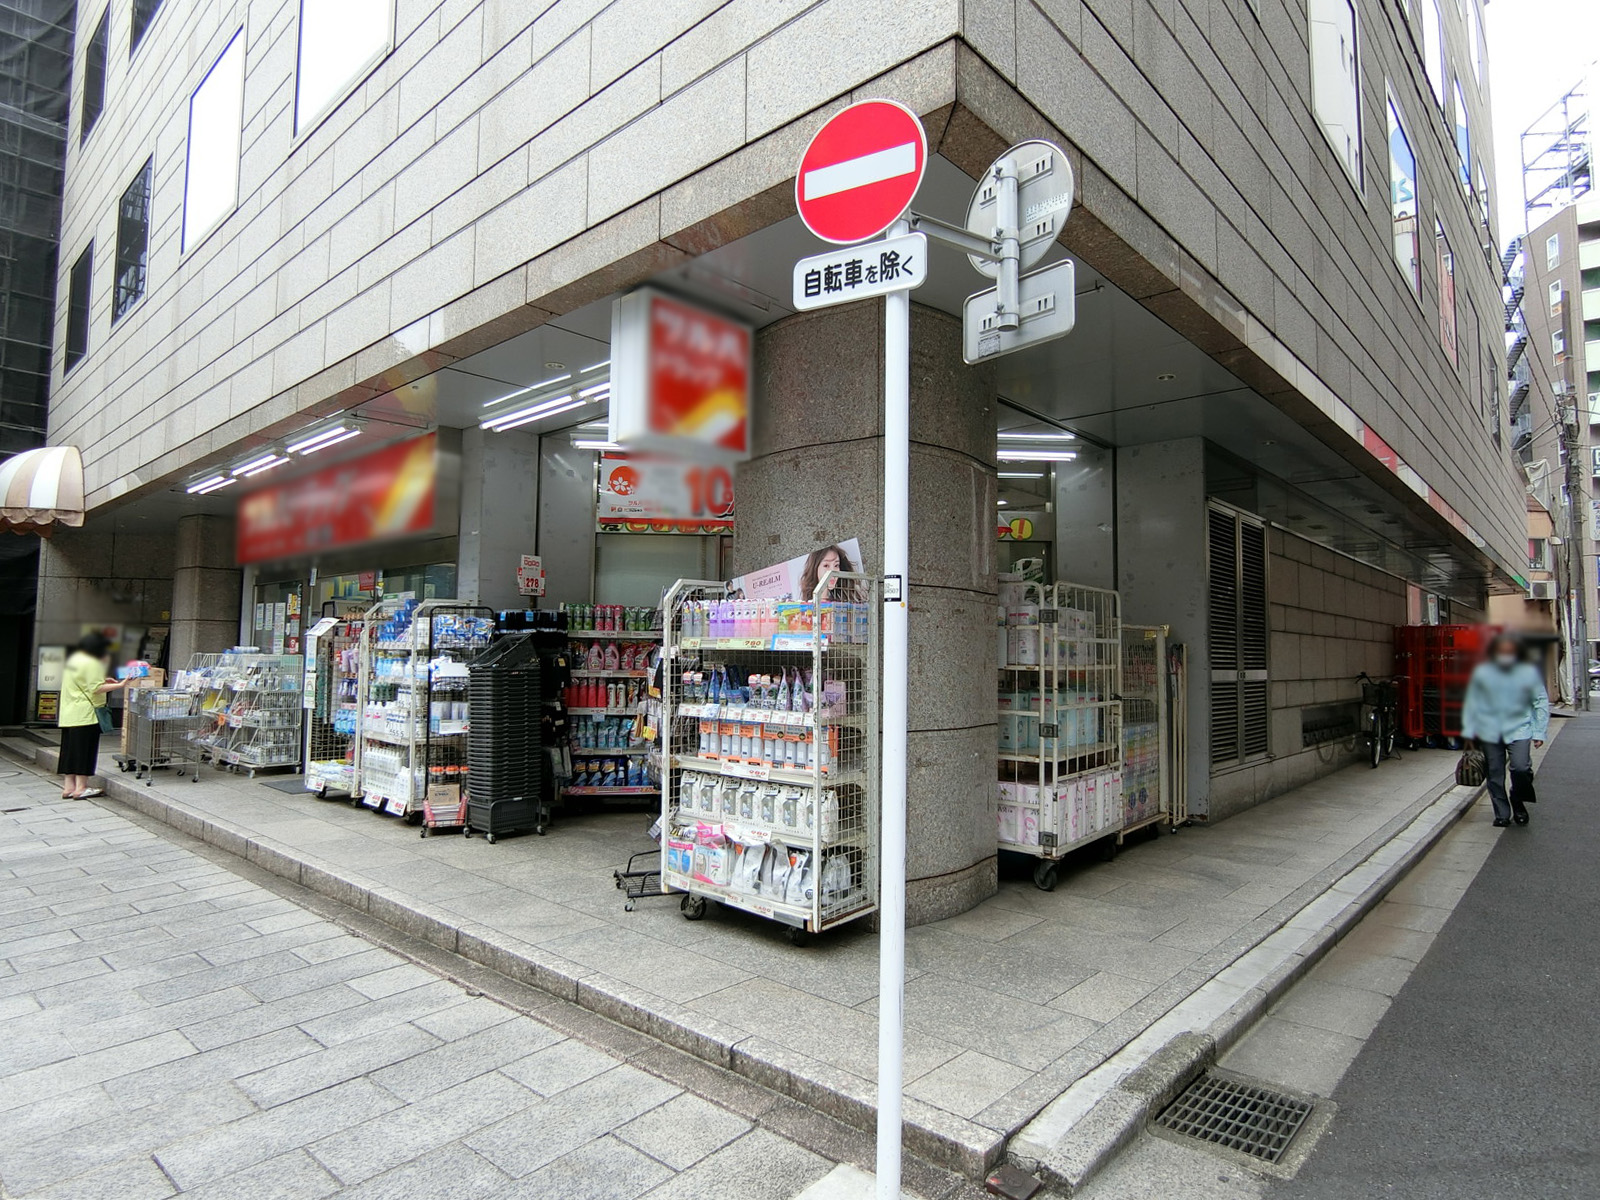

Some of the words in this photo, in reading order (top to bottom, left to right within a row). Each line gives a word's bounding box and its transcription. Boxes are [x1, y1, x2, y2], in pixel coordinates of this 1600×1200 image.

[804, 250, 913, 297] 自転車を除く
[526, 578, 539, 588] 278
